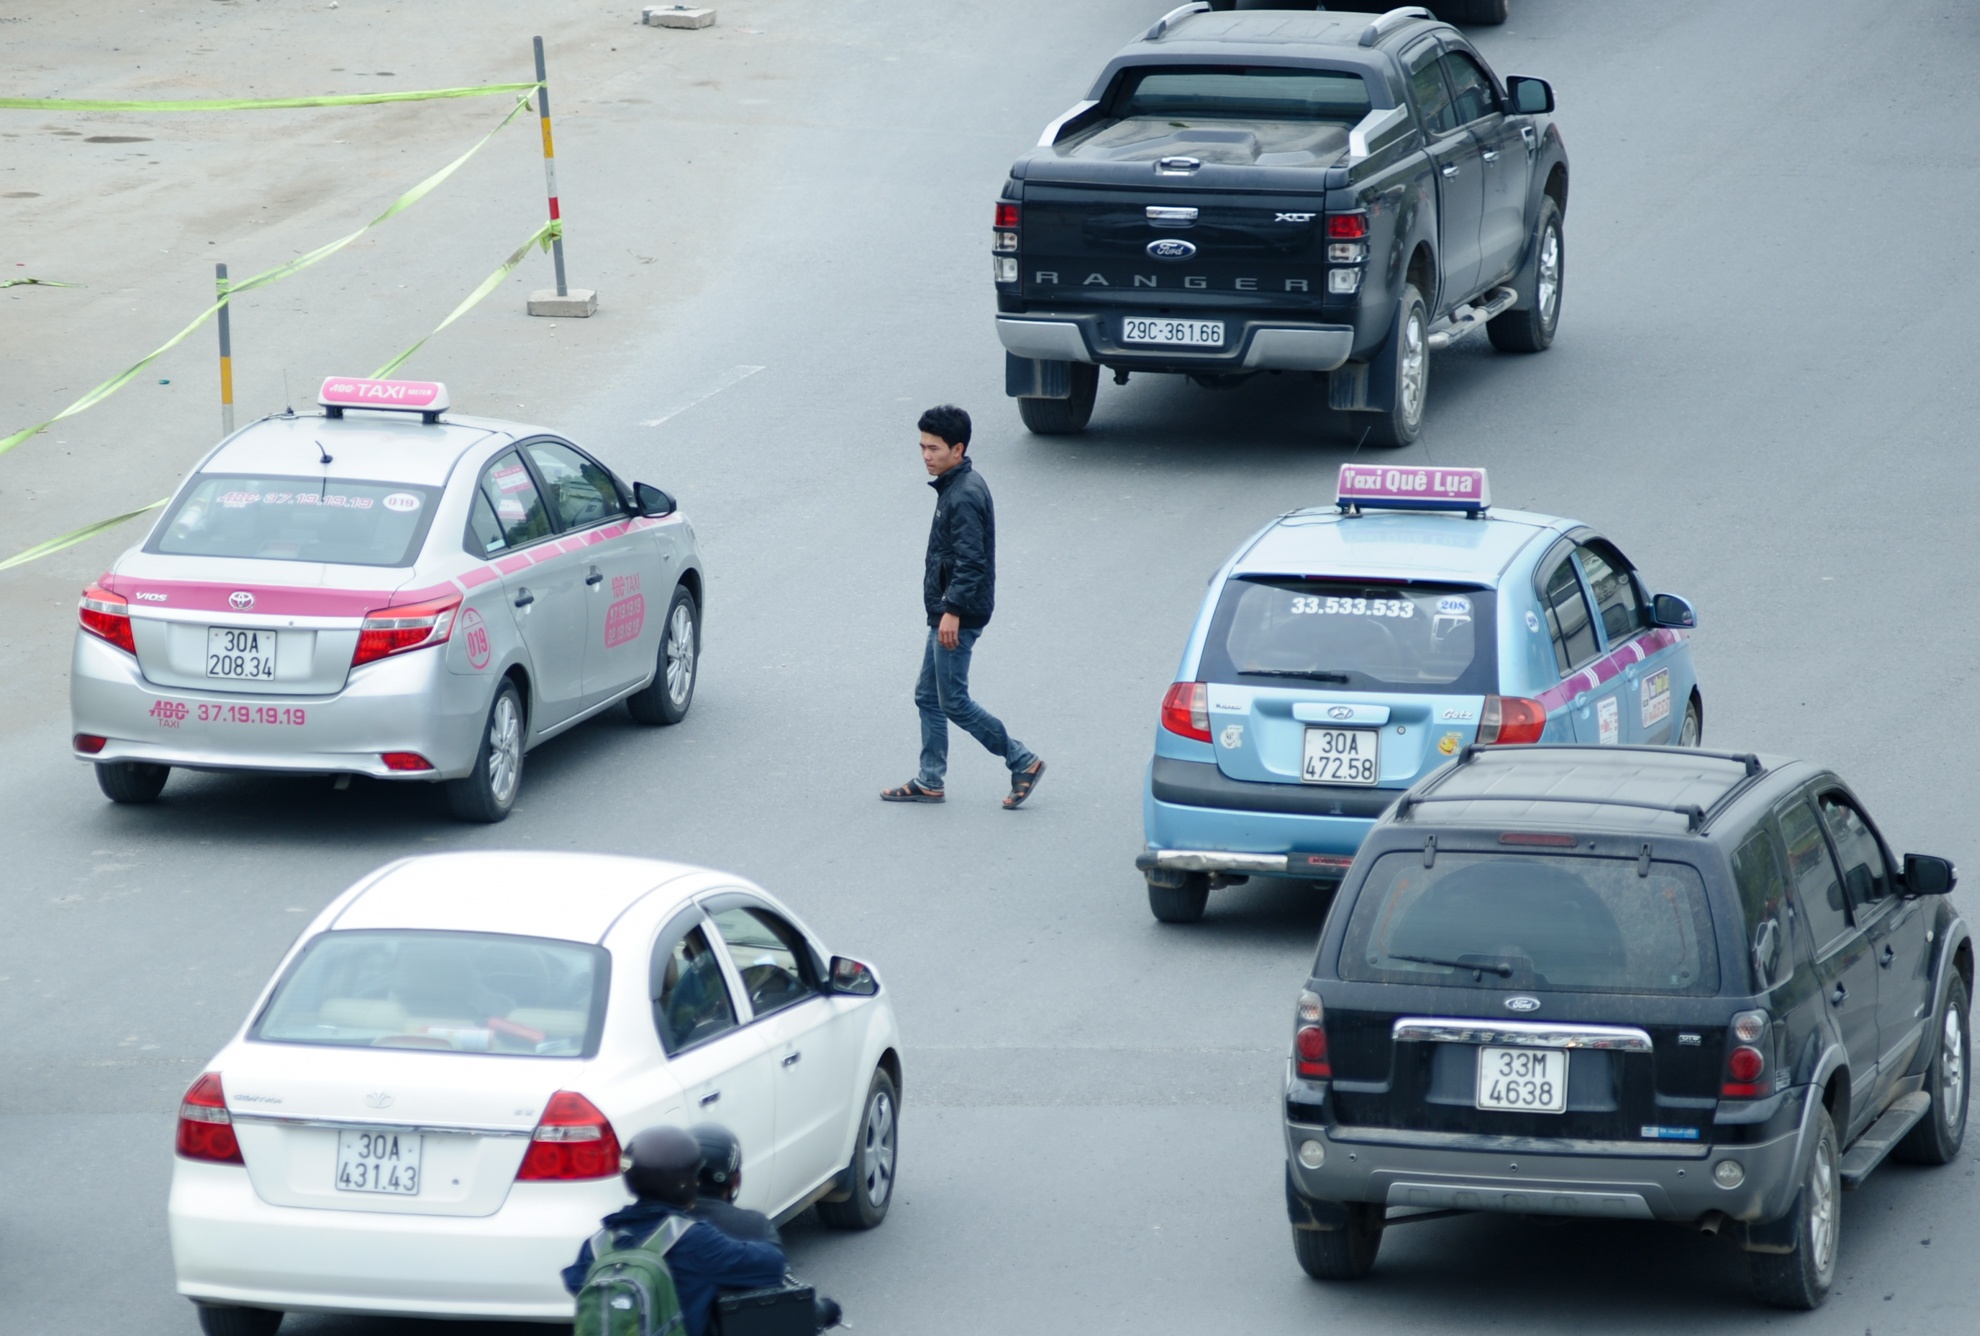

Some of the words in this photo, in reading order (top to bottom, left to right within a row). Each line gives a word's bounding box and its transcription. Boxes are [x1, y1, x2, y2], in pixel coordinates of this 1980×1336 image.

[1275, 212, 1317, 222] XLT
[1156, 241, 1184, 256] Ford
[1036, 271, 1309, 292] RANGER
[1126, 320, 1222, 344] 29C-361.66
[357, 383, 406, 399] TAXI
[1345, 469, 1383, 490] Taxi
[1385, 470, 1428, 493] Quê
[1433, 471, 1473, 497] Lụa
[262, 492, 374, 509] 37.19.19.19
[388, 497, 415, 508] 019
[625, 571, 640, 594] TAXI
[135, 592, 168, 602] VIOS
[1290, 597, 1416, 619] 33.533.533
[1439, 600, 1467, 612] 208
[224, 630, 260, 653] 30A
[467, 627, 489, 658] 019
[208, 654, 273, 679] 208.34
[157, 718, 181, 729] TAXI
[197, 704, 306, 726] 37.19.19.19
[1321, 732, 1360, 756] 30A
[1305, 756, 1374, 780] 472.58
[1511, 1000, 1534, 1009] Ford
[1499, 1053, 1548, 1079] 33M
[1489, 1080, 1554, 1107] 4638
[358, 1133, 401, 1162] 30A
[339, 1162, 418, 1192] 431.43
